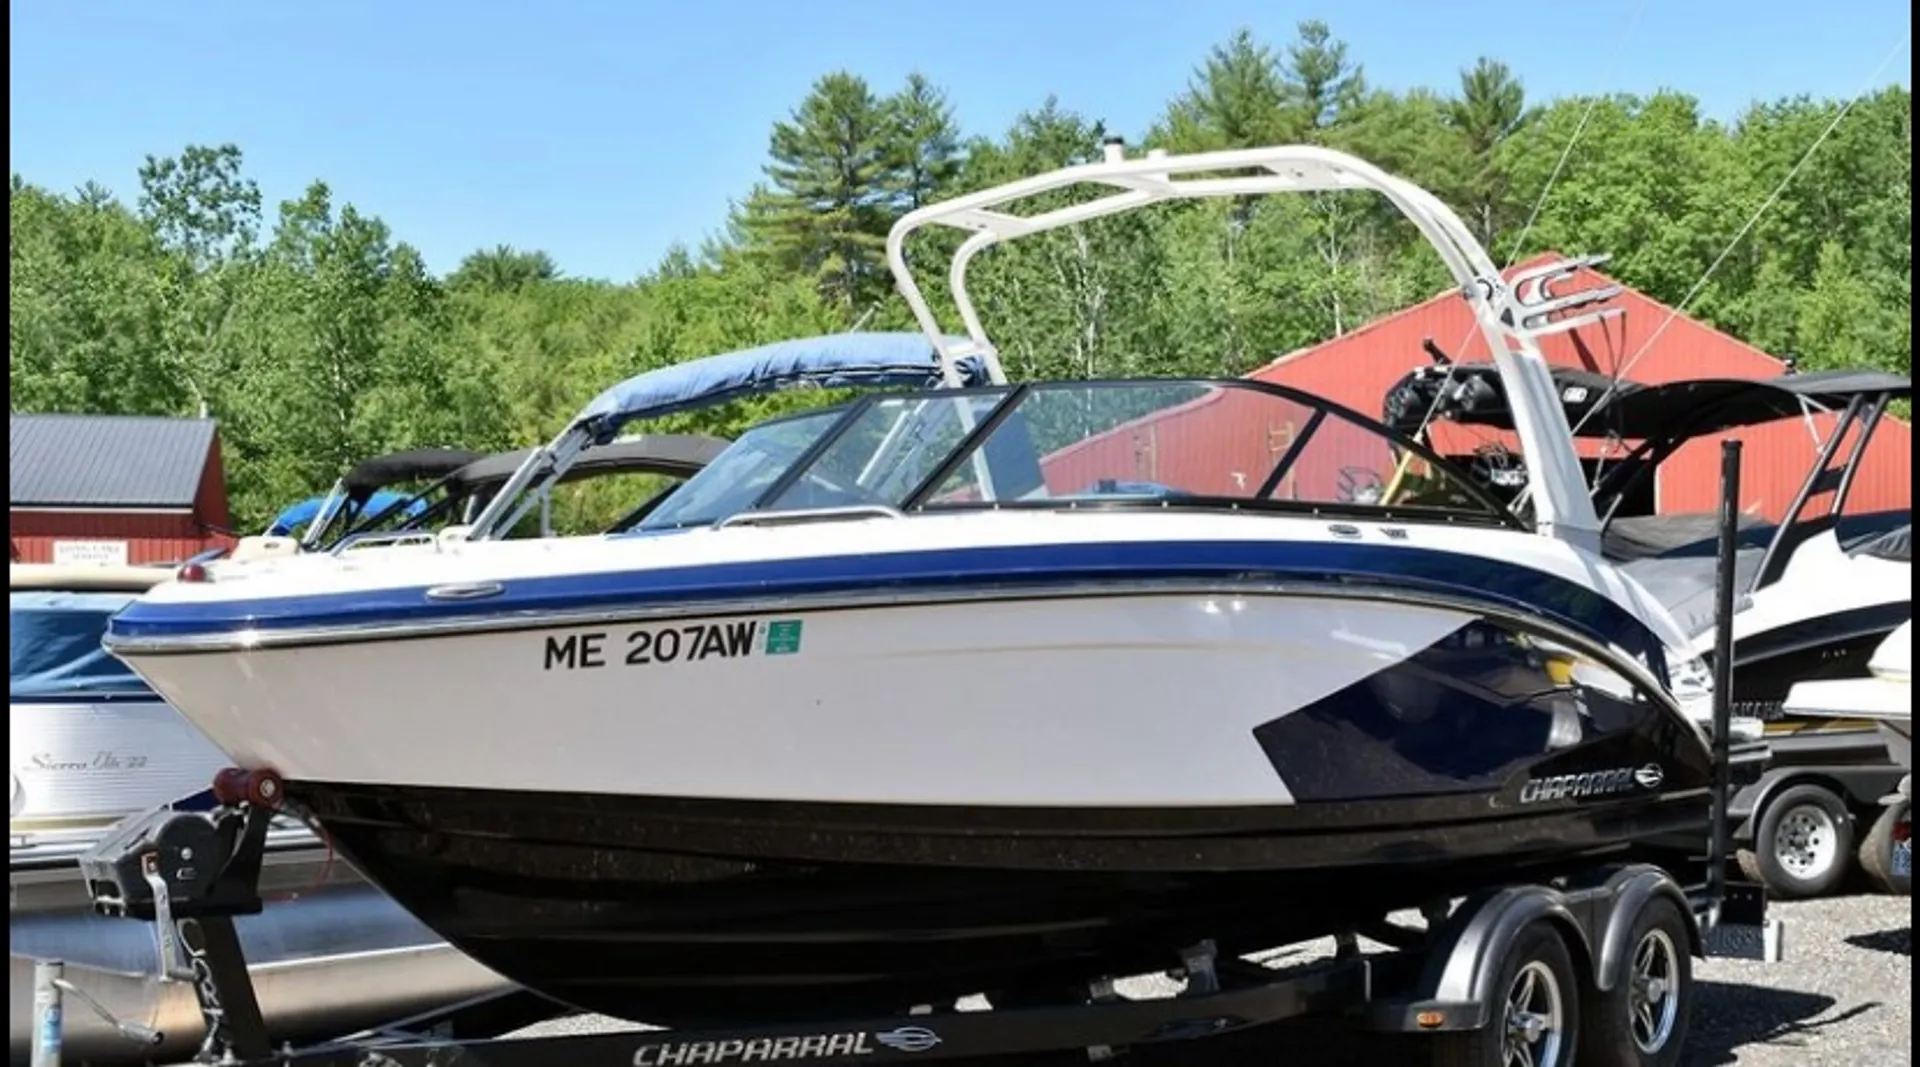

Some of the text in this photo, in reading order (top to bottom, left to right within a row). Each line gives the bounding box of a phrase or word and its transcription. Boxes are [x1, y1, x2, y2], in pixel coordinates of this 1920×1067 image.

[544, 633, 607, 670] ME
[1519, 767, 1634, 804] CHAPARRAL
[632, 1031, 874, 1067] CHAPARRAL
